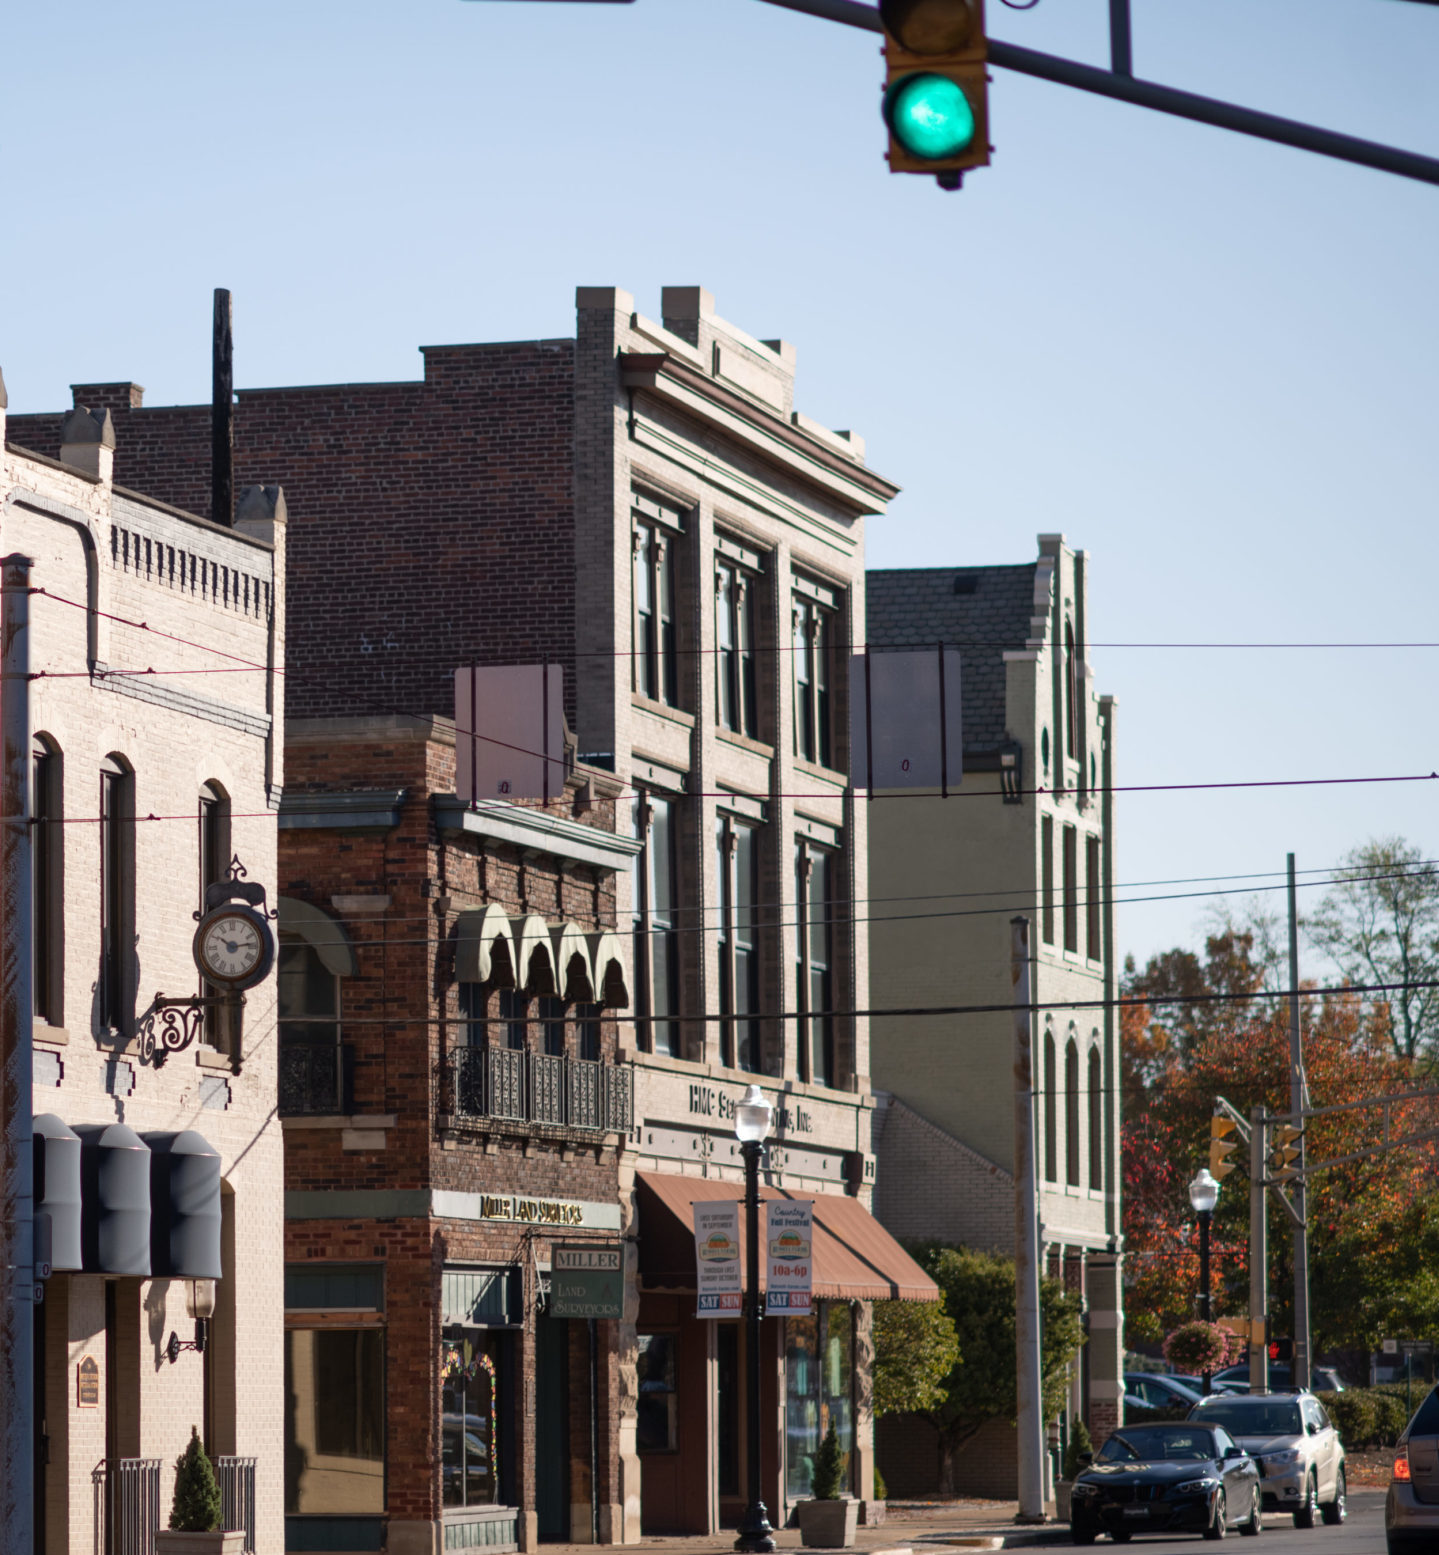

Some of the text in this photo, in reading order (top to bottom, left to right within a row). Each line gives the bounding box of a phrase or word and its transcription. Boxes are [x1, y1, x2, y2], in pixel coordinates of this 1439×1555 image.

[689, 1084, 715, 1116] HMC
[480, 1195, 584, 1225] MILLER LAND SURVEYORS
[771, 1218, 810, 1226] Fall Festival
[557, 1253, 618, 1268] MILLER
[773, 1264, 808, 1278] 10a-6p
[557, 1283, 586, 1297] LAND
[701, 1294, 740, 1308] SAT SUN
[770, 1293, 810, 1306] SAT SUN
[554, 1300, 620, 1315] SURVEYORS
